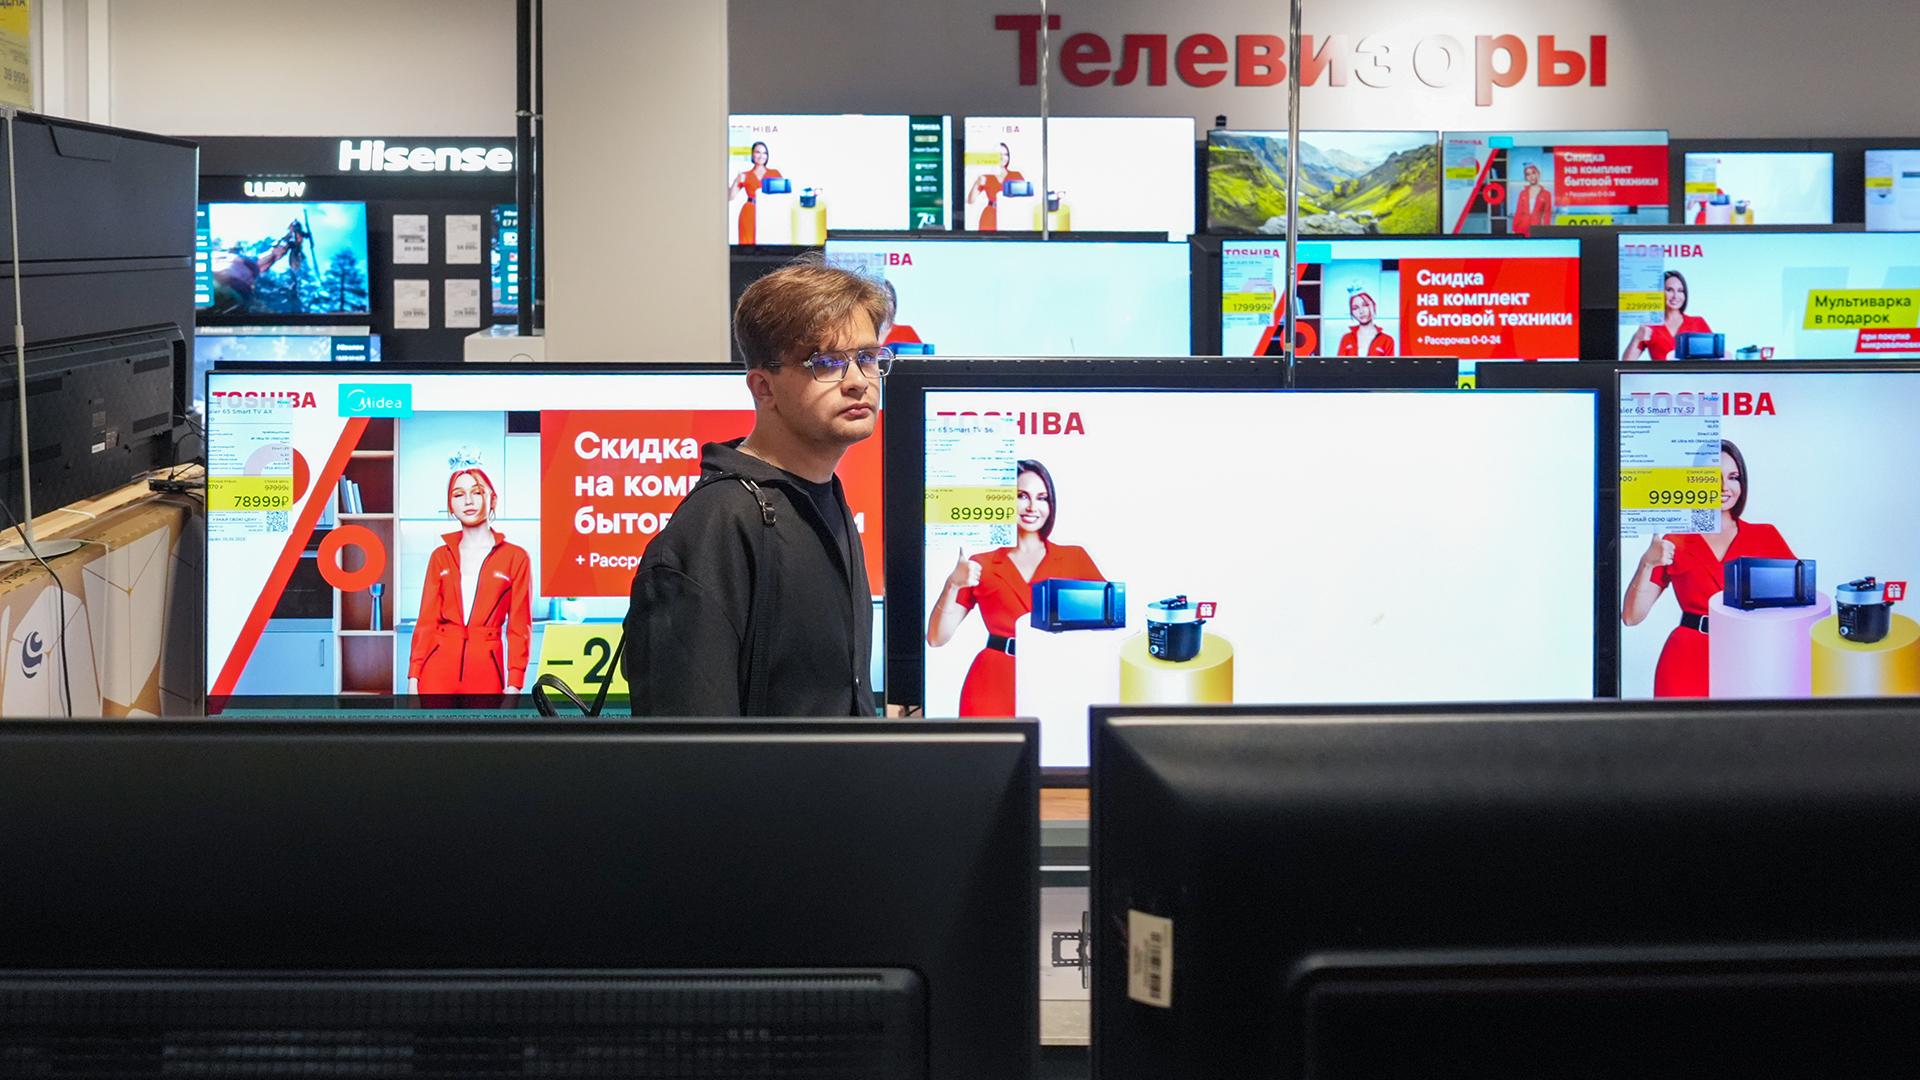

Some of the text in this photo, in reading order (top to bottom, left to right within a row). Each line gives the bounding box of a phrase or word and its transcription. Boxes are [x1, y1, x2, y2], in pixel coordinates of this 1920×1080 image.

[995, 14, 1608, 106] Телевизоры
[338, 139, 514, 172] Hisense
[1564, 152, 1605, 164] Скидка
[1564, 165, 1633, 174] на комплект
[1564, 176, 1659, 186] бытовой техники
[1416, 269, 1484, 287] Скидка
[1417, 292, 1530, 306] на комплект
[1815, 295, 1912, 309] Мультиварка
[1416, 310, 1573, 326] бытовой техники
[1815, 313, 1890, 327] в подарок
[349, 392, 402, 410] Midea
[1647, 406, 1670, 414] Smart
[937, 411, 1085, 435] THIBA
[575, 431, 698, 463] Скидка
[575, 475, 614, 496] на
[547, 637, 614, 684] -2
